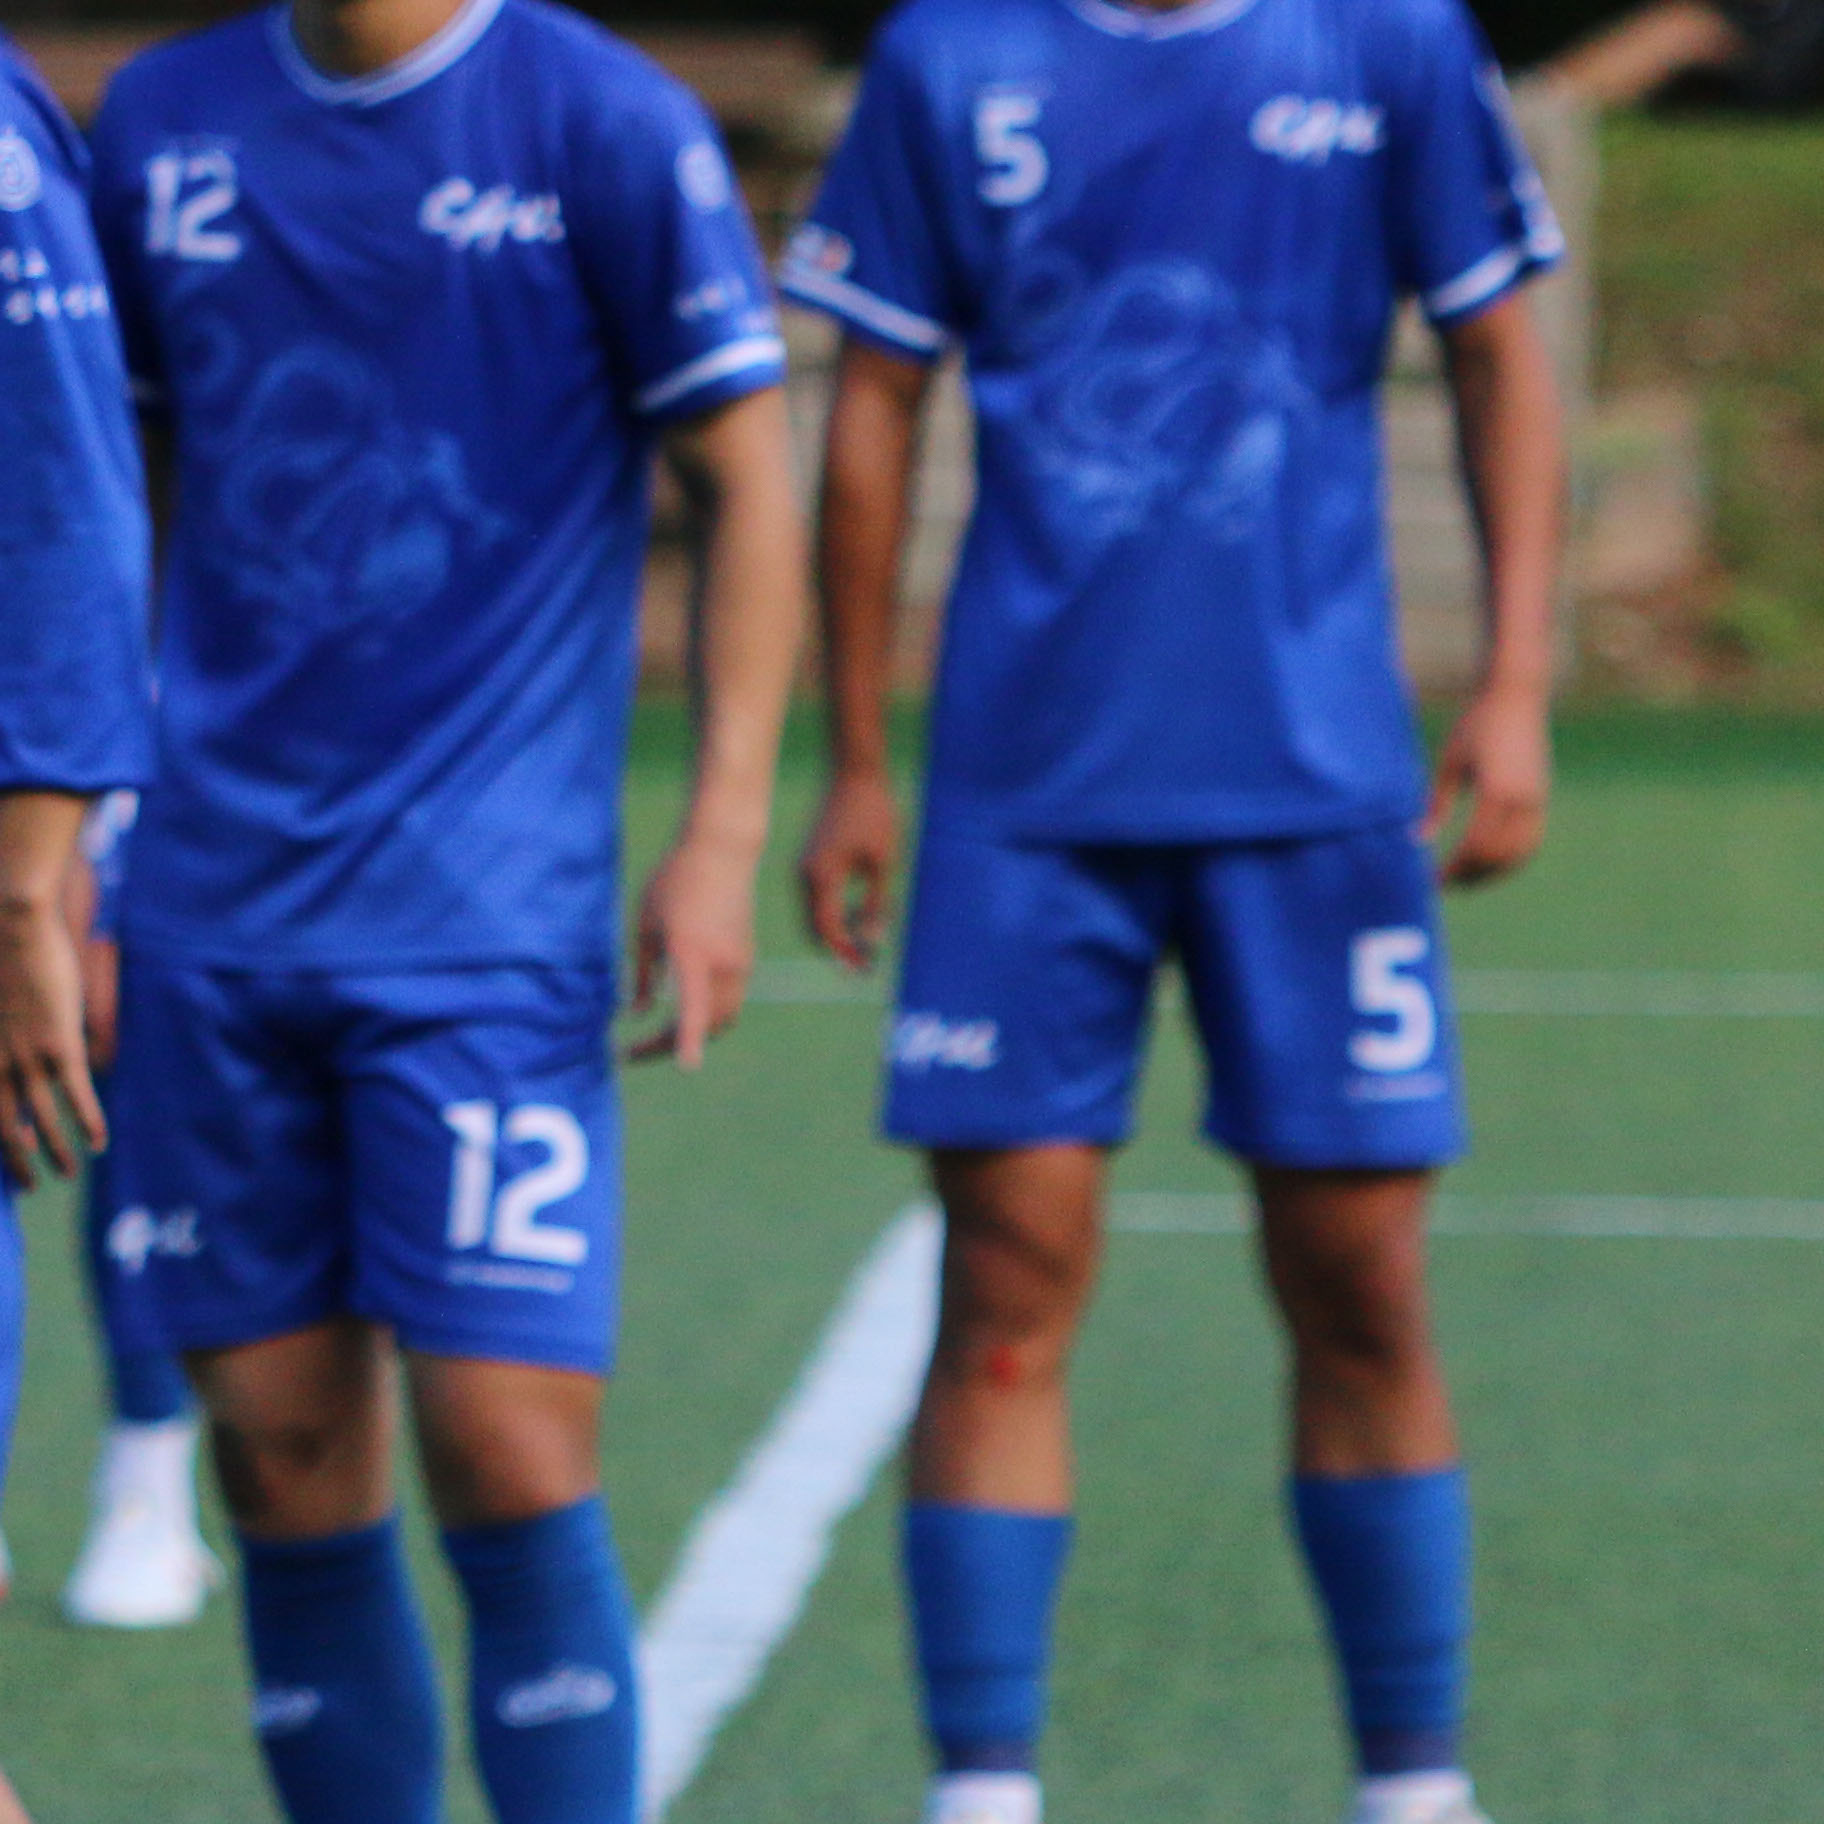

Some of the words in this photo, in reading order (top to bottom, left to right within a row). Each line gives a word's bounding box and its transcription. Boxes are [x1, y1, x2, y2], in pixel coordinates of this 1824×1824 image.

[146, 148, 243, 262] 12
[973, 91, 1050, 208] 5
[1348, 926, 1435, 1073] 5
[442, 1099, 590, 1266] 12
